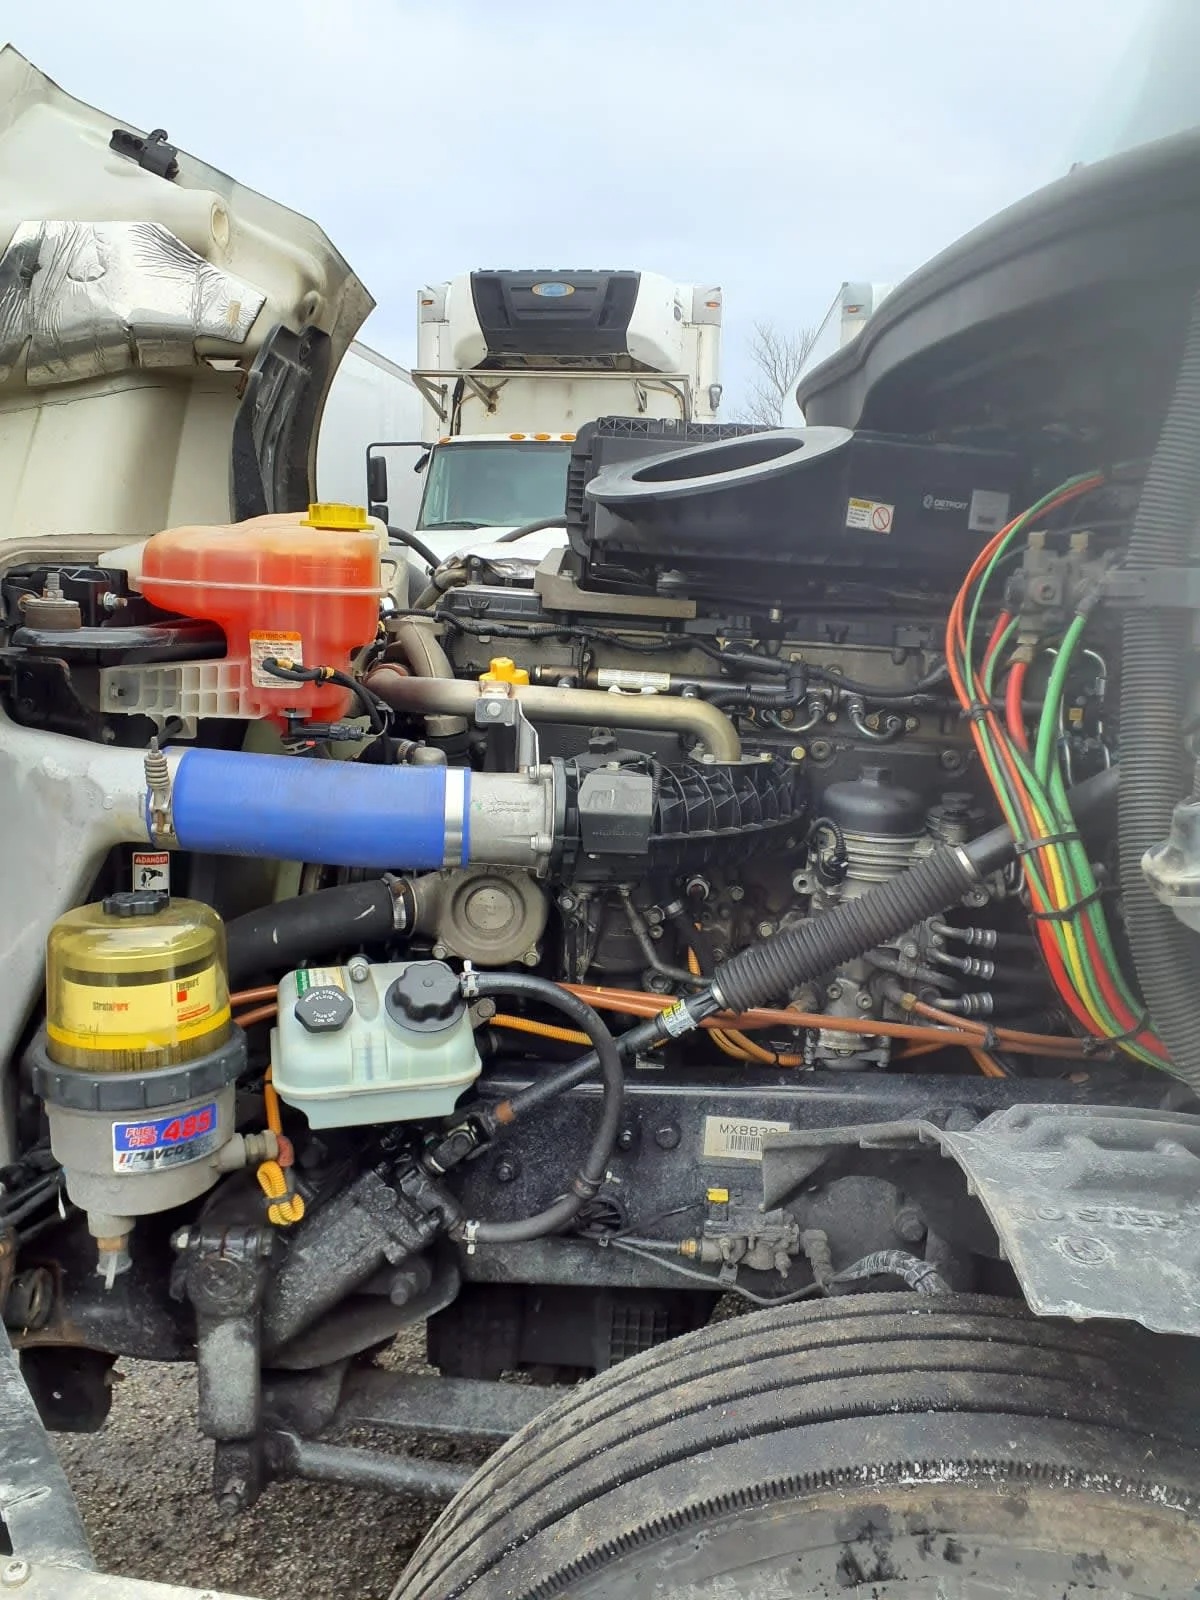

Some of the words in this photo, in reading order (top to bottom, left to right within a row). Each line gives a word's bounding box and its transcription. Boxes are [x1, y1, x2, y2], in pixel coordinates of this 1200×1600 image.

[934, 499, 968, 510] DETROIT
[142, 855, 168, 864] DANGER
[304, 991, 320, 1003] POWER
[125, 1126, 157, 1138] FUEL
[161, 1108, 211, 1141] 485
[128, 1135, 157, 1148] PRO
